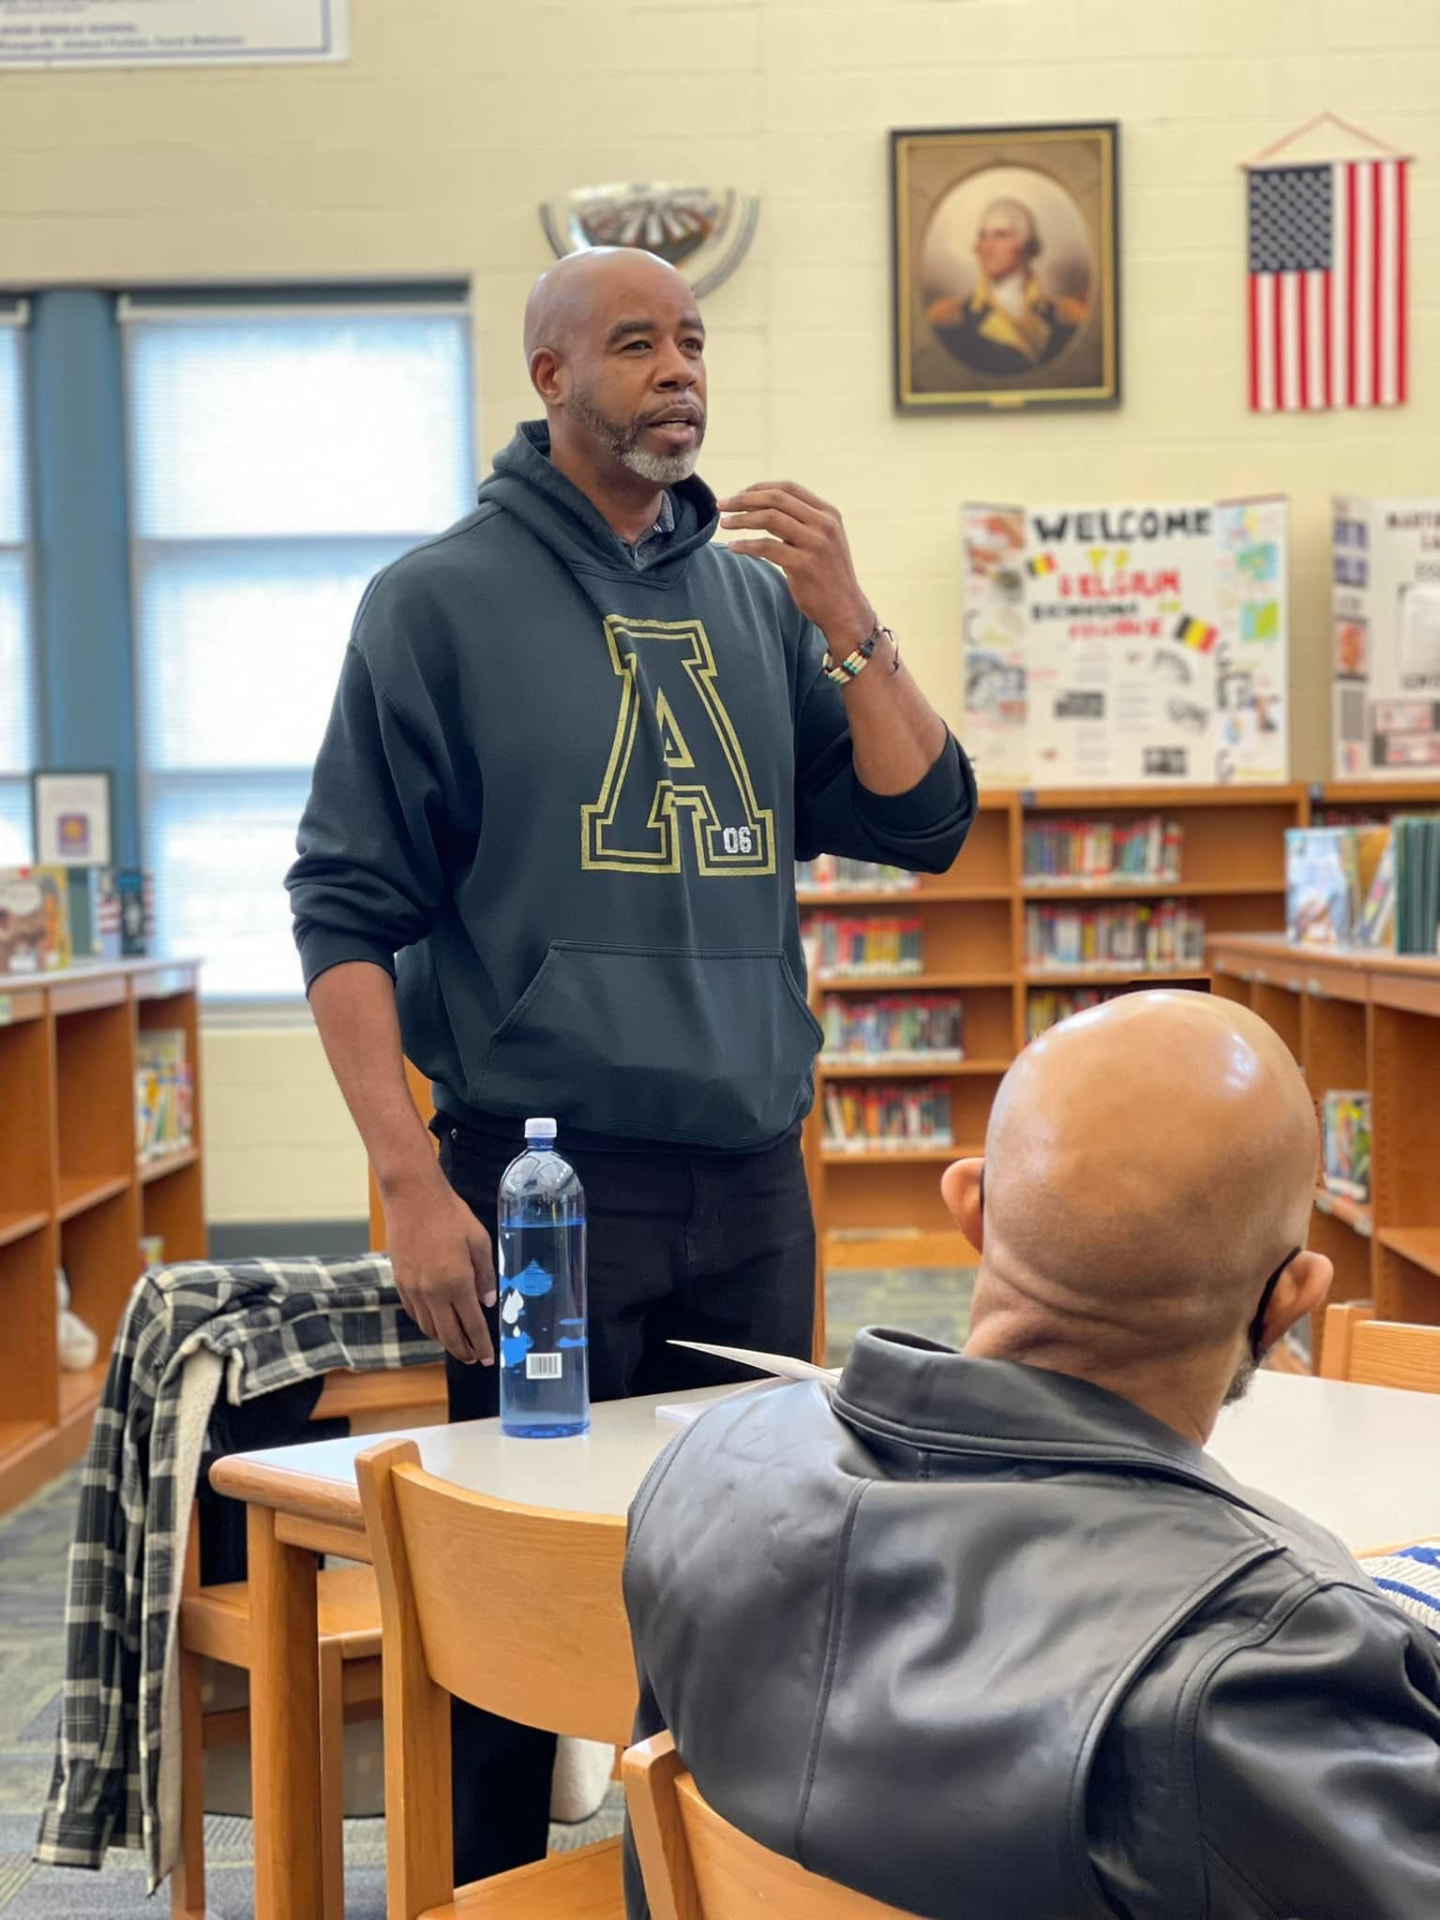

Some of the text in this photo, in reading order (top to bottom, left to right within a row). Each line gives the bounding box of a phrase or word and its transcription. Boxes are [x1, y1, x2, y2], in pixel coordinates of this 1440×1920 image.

[1032, 508, 1212, 543] WELCOME
[580, 613, 776, 876] A
[723, 826, 752, 853] 06
